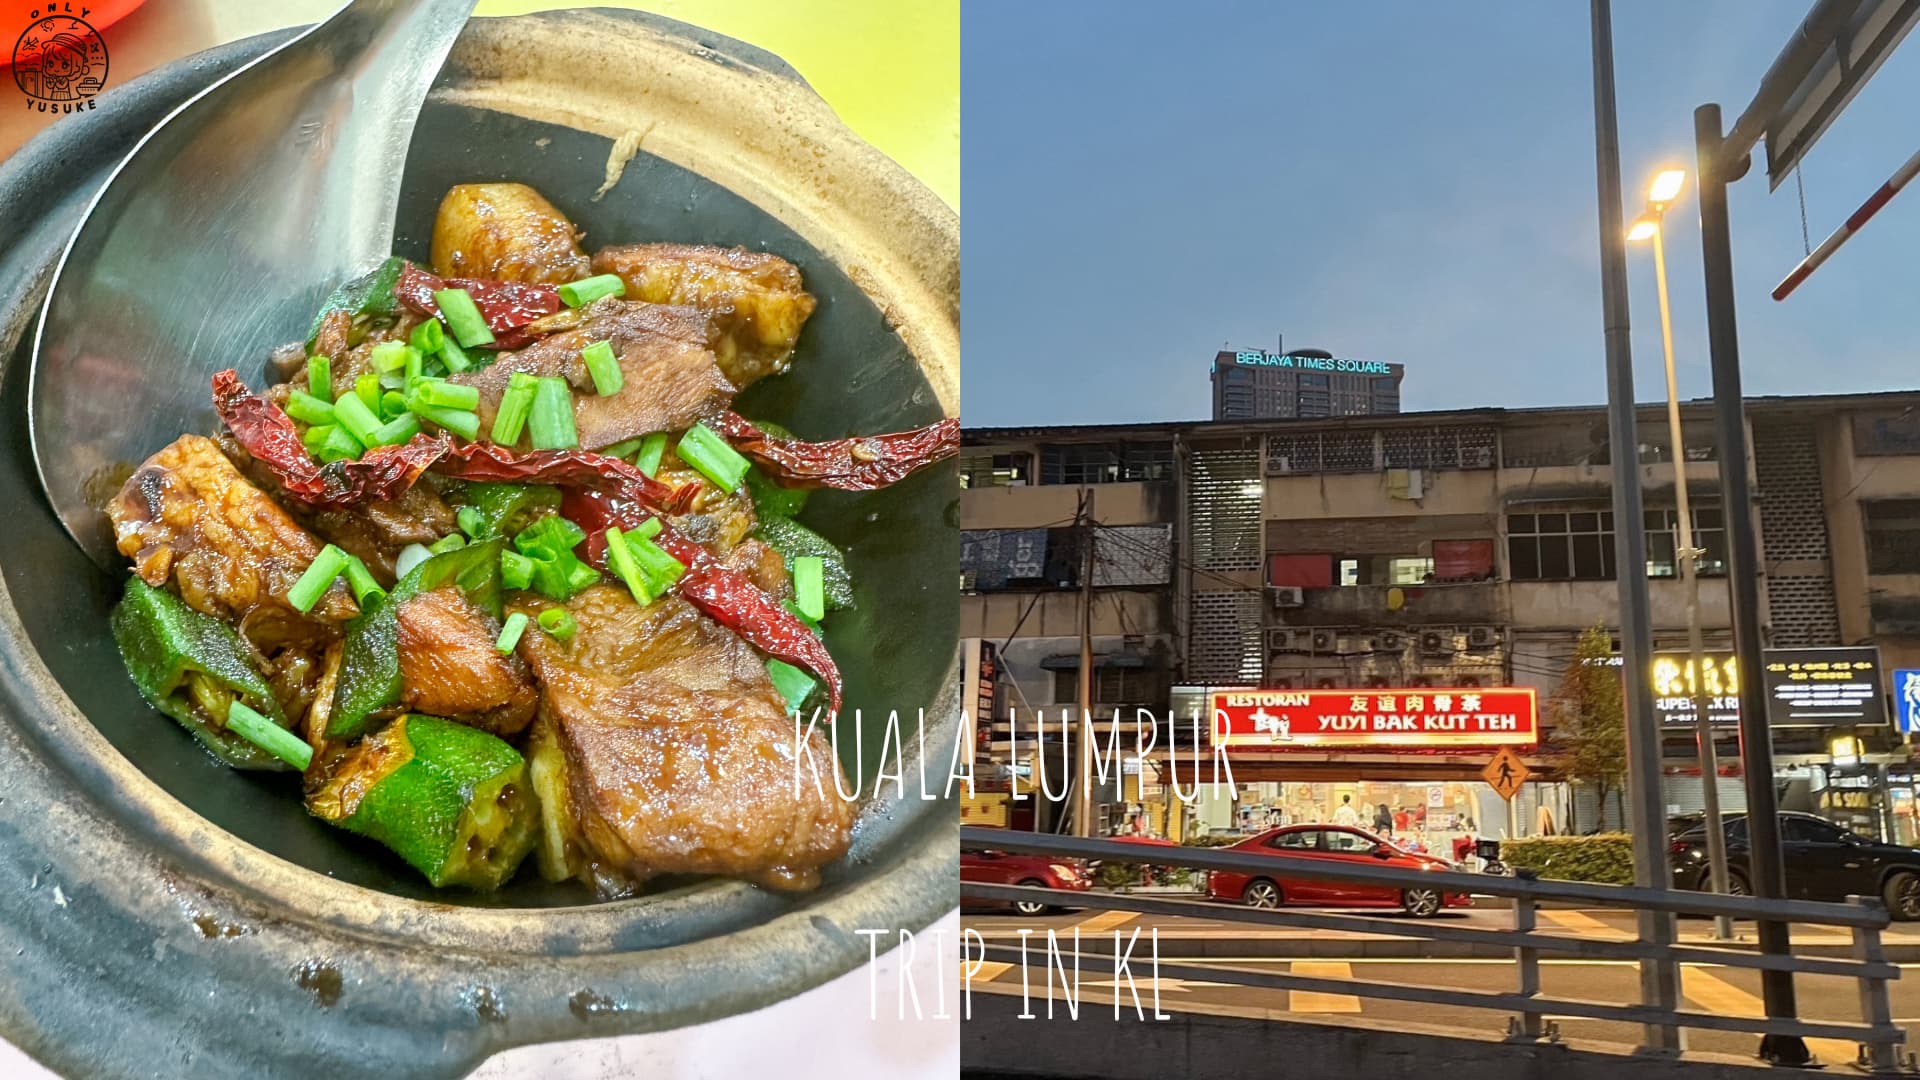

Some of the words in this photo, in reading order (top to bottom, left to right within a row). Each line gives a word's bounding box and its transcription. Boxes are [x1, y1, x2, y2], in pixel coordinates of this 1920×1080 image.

[1236, 352, 1293, 368] BERJAYA
[1295, 356, 1335, 371] TIMES
[1337, 360, 1391, 374] SQUARE
[1226, 694, 1310, 707] RESTORAN
[1318, 715, 1367, 730] YUYI
[1373, 714, 1418, 730] BAK
[1424, 714, 1469, 730] KUT
[1474, 713, 1517, 730] TEH
